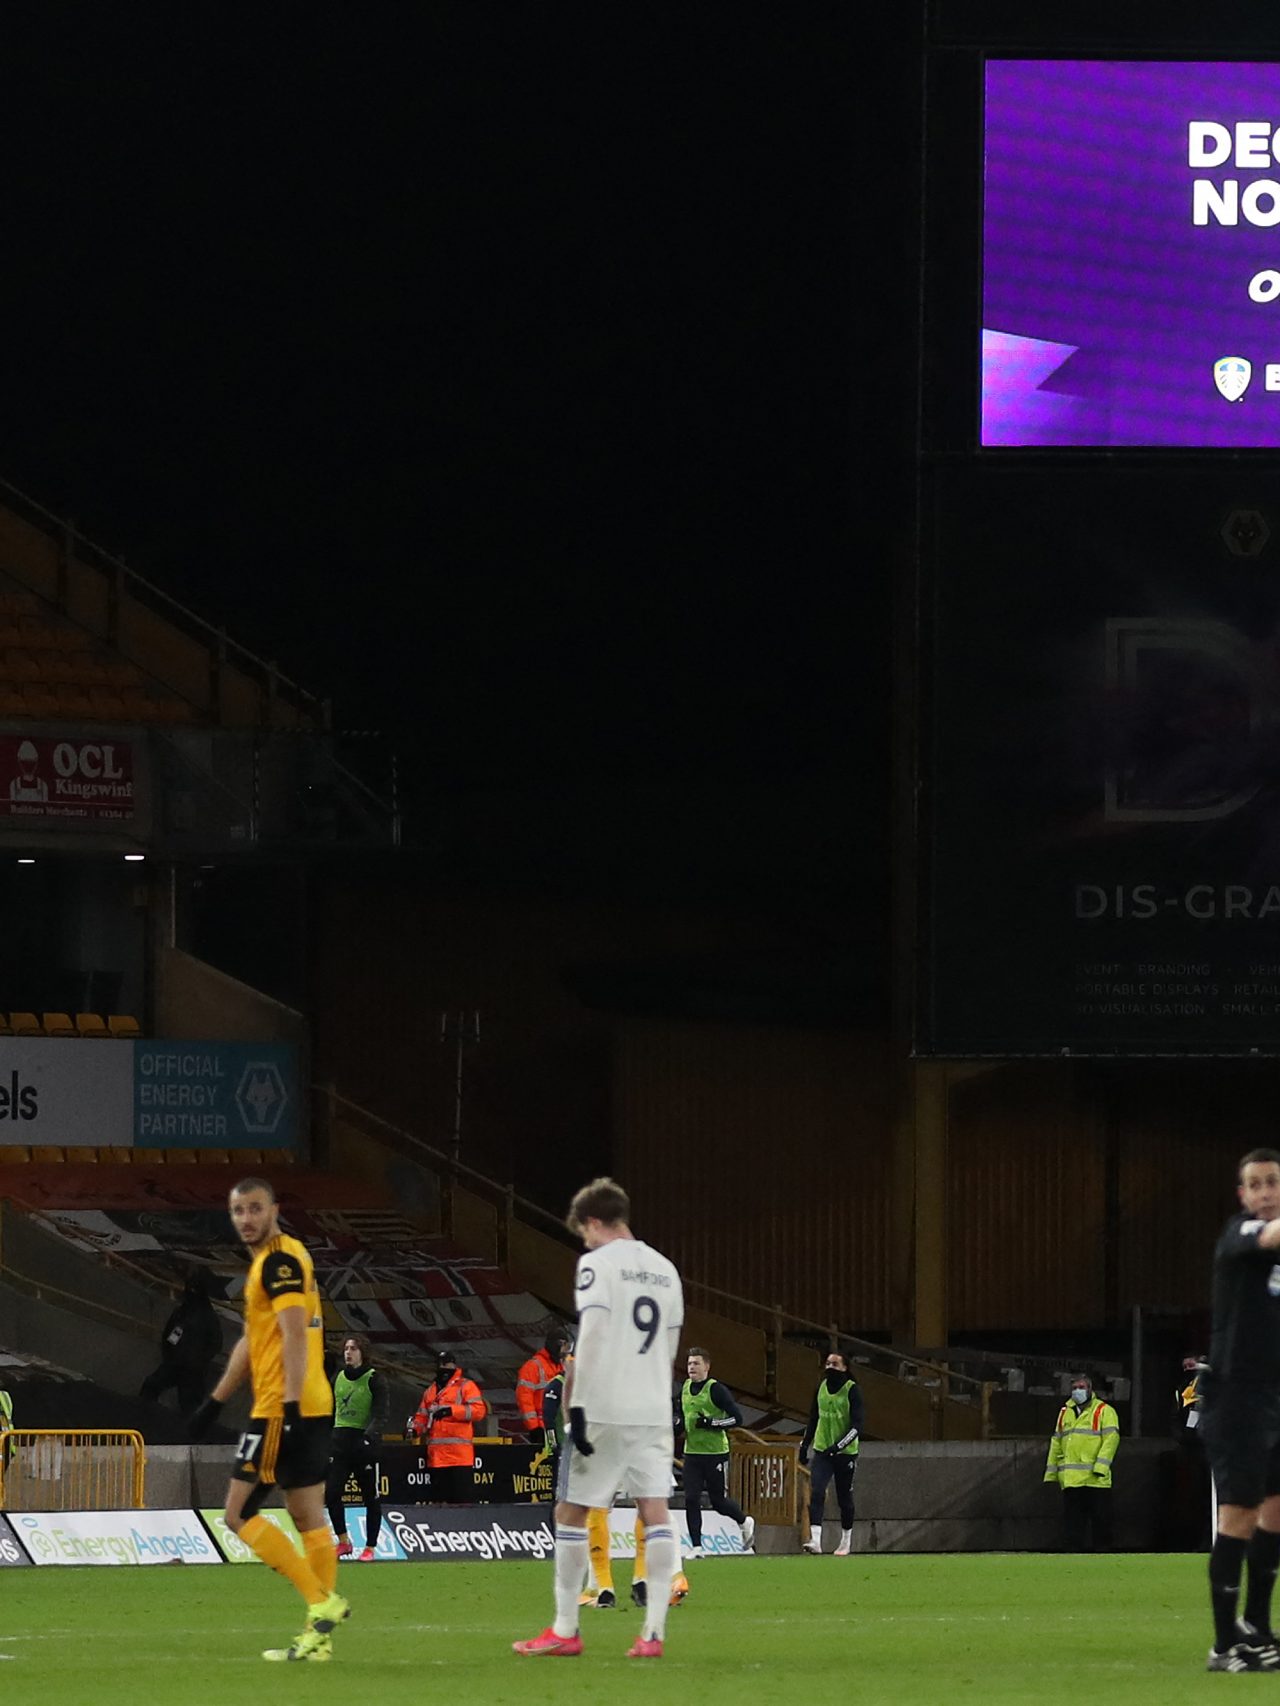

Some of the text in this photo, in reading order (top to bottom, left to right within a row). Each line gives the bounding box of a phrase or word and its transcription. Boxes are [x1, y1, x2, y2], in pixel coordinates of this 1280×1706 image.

[53, 743, 123, 779] OCL
[1138, 964, 1210, 976] BRANDING
[1075, 983, 1145, 996] PORTABLE
[1153, 983, 1218, 996] DISPLAYS
[1234, 983, 1280, 996] RETAIL
[1100, 1003, 1205, 1016] VISUALISATION
[1222, 1003, 1266, 1016] SMALL
[140, 1054, 225, 1077] OFFICIAL
[140, 1084, 217, 1106] ENERGY
[140, 1113, 227, 1136] PARTNER
[621, 1268, 671, 1288] BAMFORD
[633, 1295, 660, 1354] 9
[52, 1527, 208, 1563] EnergyAngels
[416, 1521, 555, 1560] EnergyAngel
